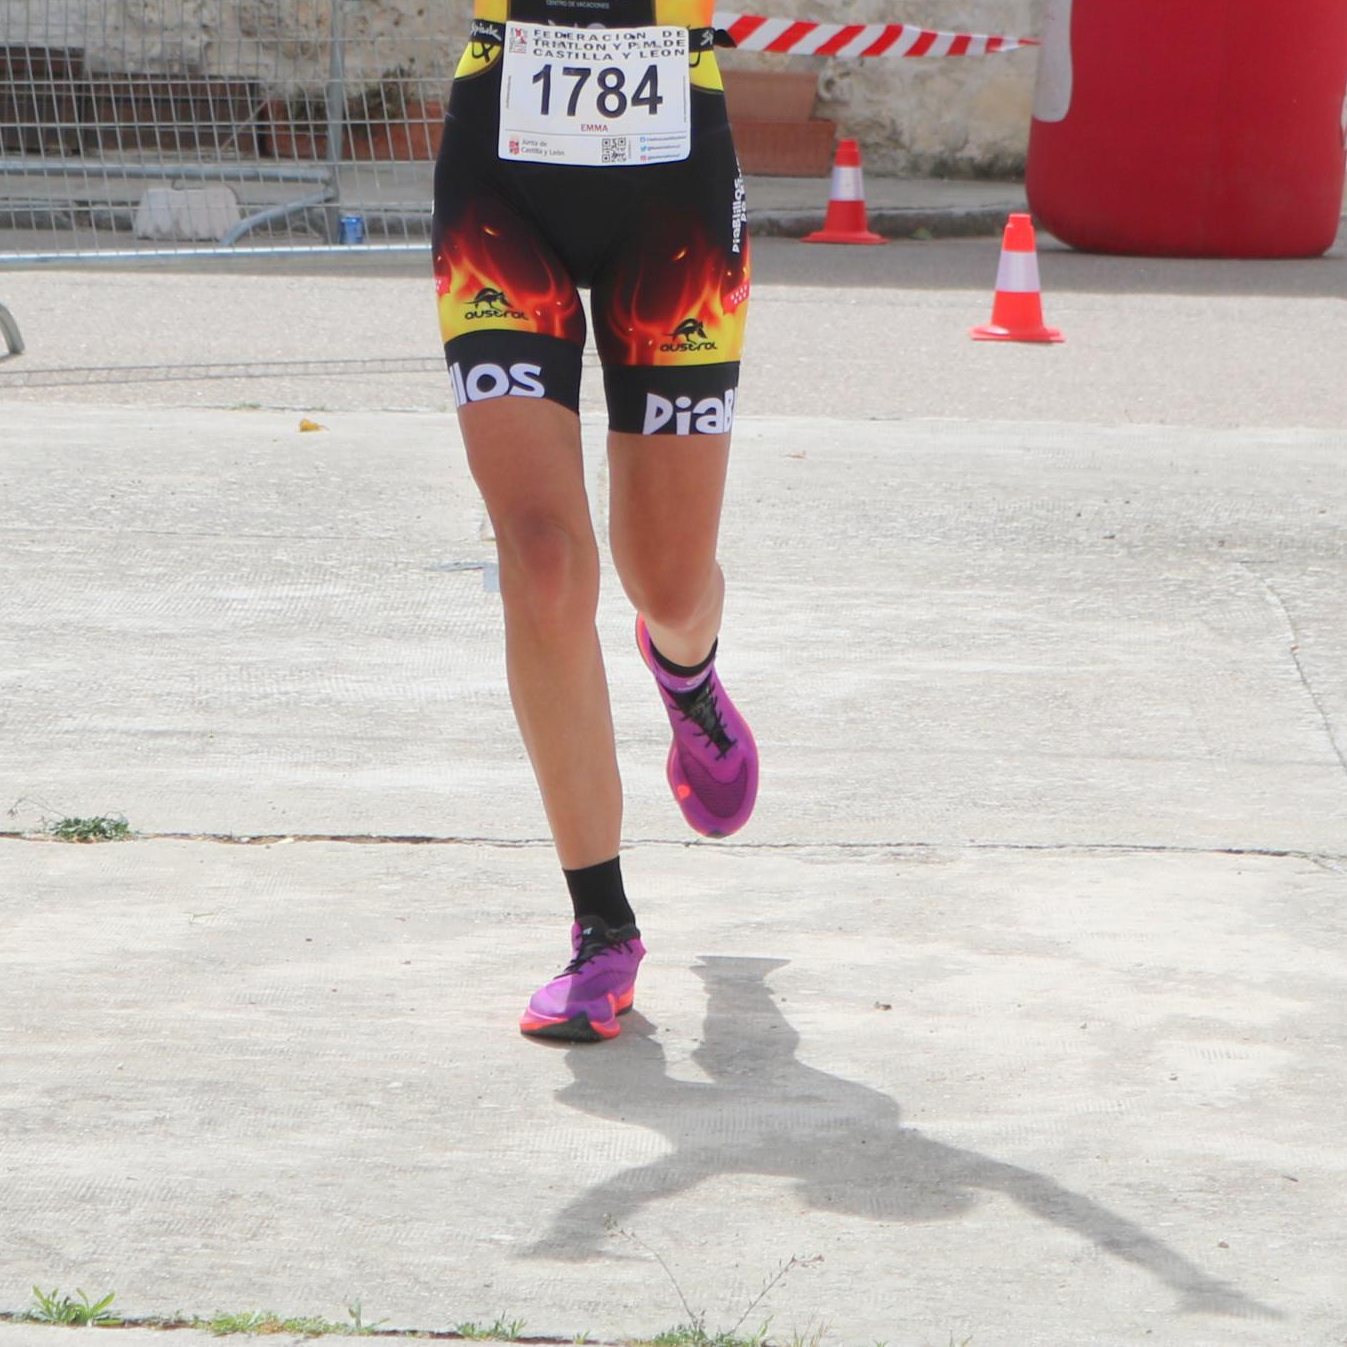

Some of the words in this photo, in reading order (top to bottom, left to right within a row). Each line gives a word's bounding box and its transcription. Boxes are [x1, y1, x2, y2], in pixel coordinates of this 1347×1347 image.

[662, 30, 686, 38] DE
[533, 38, 606, 51] TRIATLON
[533, 48, 613, 61] CASTILLA
[622, 52, 631, 60] Y
[639, 49, 685, 59] LEON
[532, 63, 663, 119] 1784
[580, 123, 609, 132] EMMA
